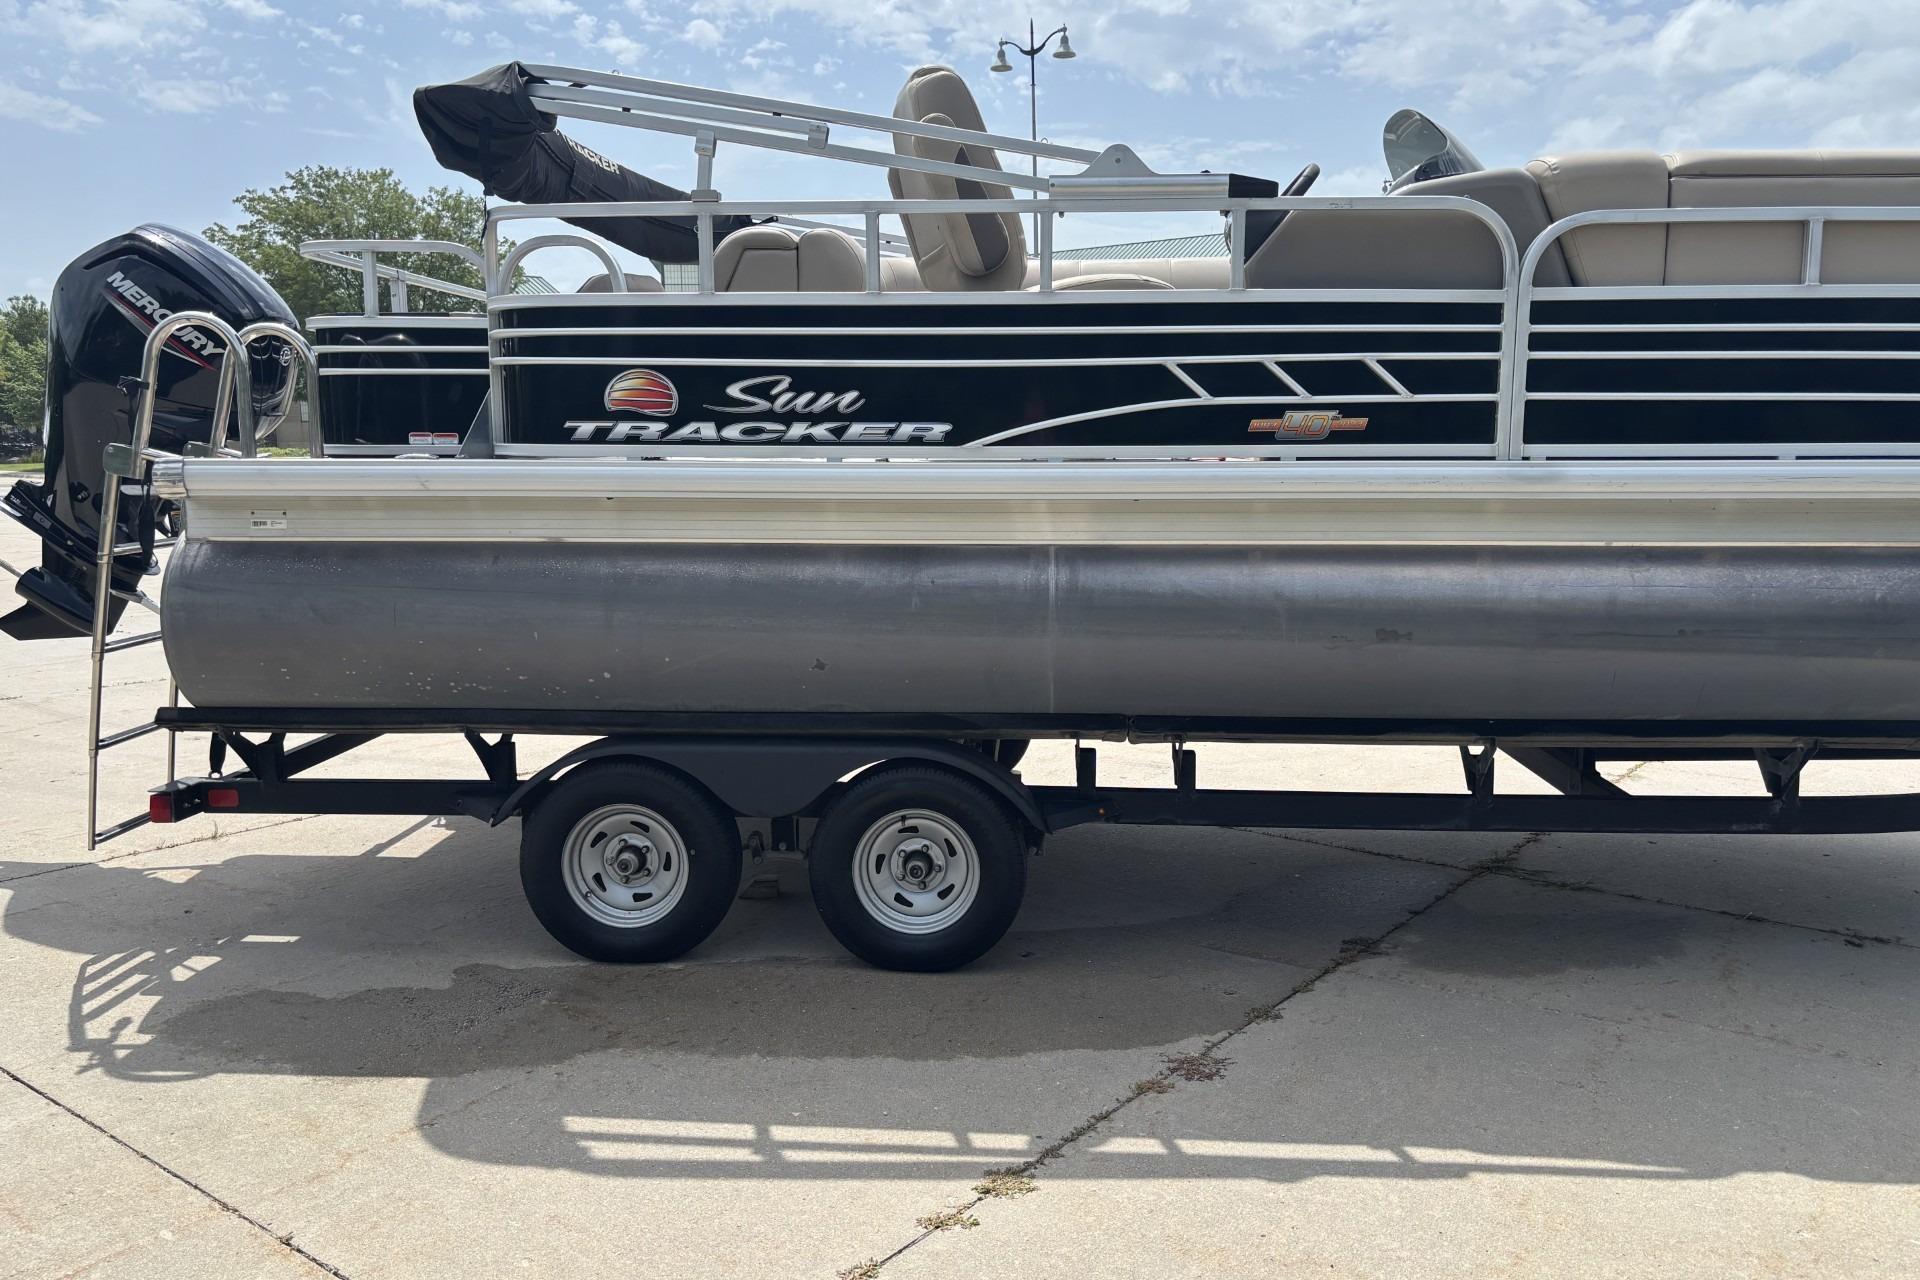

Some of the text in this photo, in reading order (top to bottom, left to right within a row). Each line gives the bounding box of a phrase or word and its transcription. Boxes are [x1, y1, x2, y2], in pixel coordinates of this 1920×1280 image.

[702, 374, 866, 413] Sun
[563, 420, 954, 443] TRACKER
[1282, 414, 1331, 436] 40
